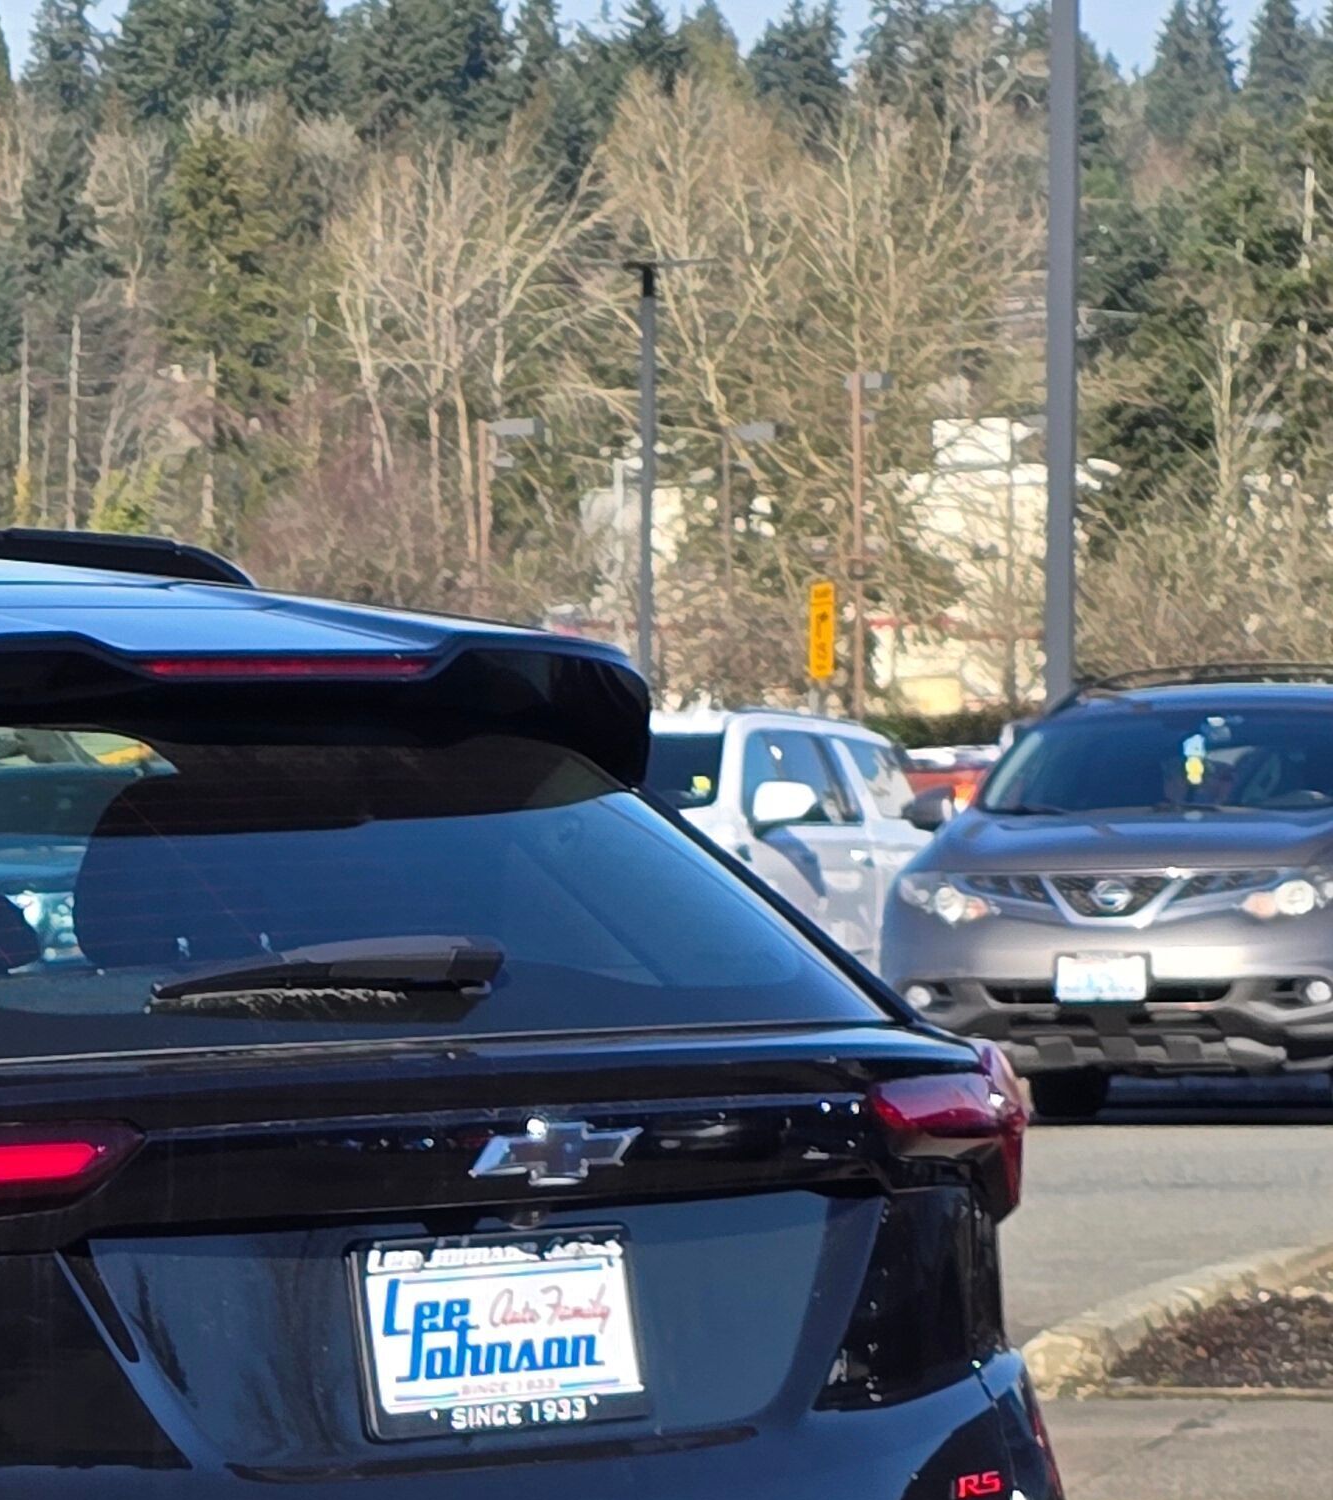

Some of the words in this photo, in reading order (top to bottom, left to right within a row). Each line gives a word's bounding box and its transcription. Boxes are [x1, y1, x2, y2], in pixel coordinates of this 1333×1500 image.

[383, 1279, 479, 1337] Lee
[395, 1312, 606, 1383] Johnson
[451, 1404, 522, 1430] SINCE
[530, 1397, 587, 1423] 1933
[957, 1470, 1002, 1499] RS
